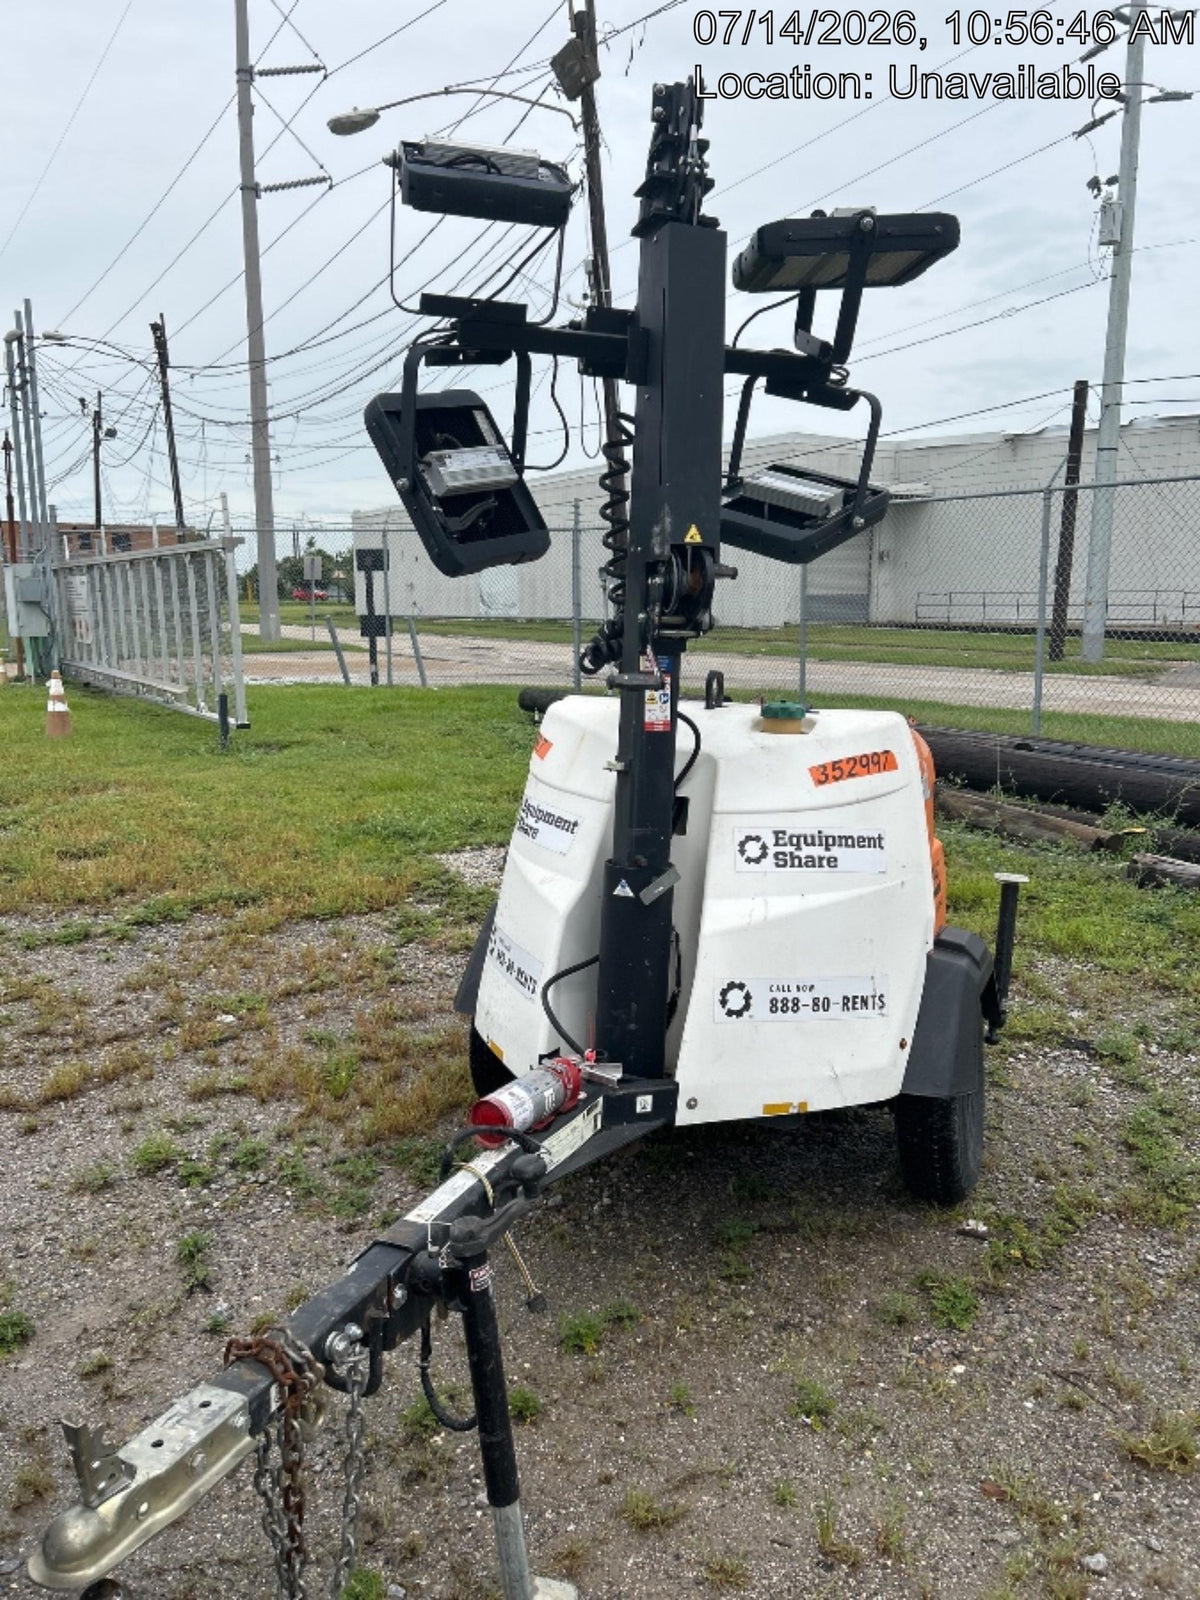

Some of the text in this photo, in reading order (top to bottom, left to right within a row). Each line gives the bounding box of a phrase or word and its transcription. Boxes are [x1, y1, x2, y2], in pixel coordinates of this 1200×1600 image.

[816, 750, 891, 785] 352997
[772, 829, 885, 852] Equipment
[772, 851, 839, 868] Share
[769, 984, 816, 993] CALL NOW
[769, 993, 886, 1014] 888-80-RENTS
